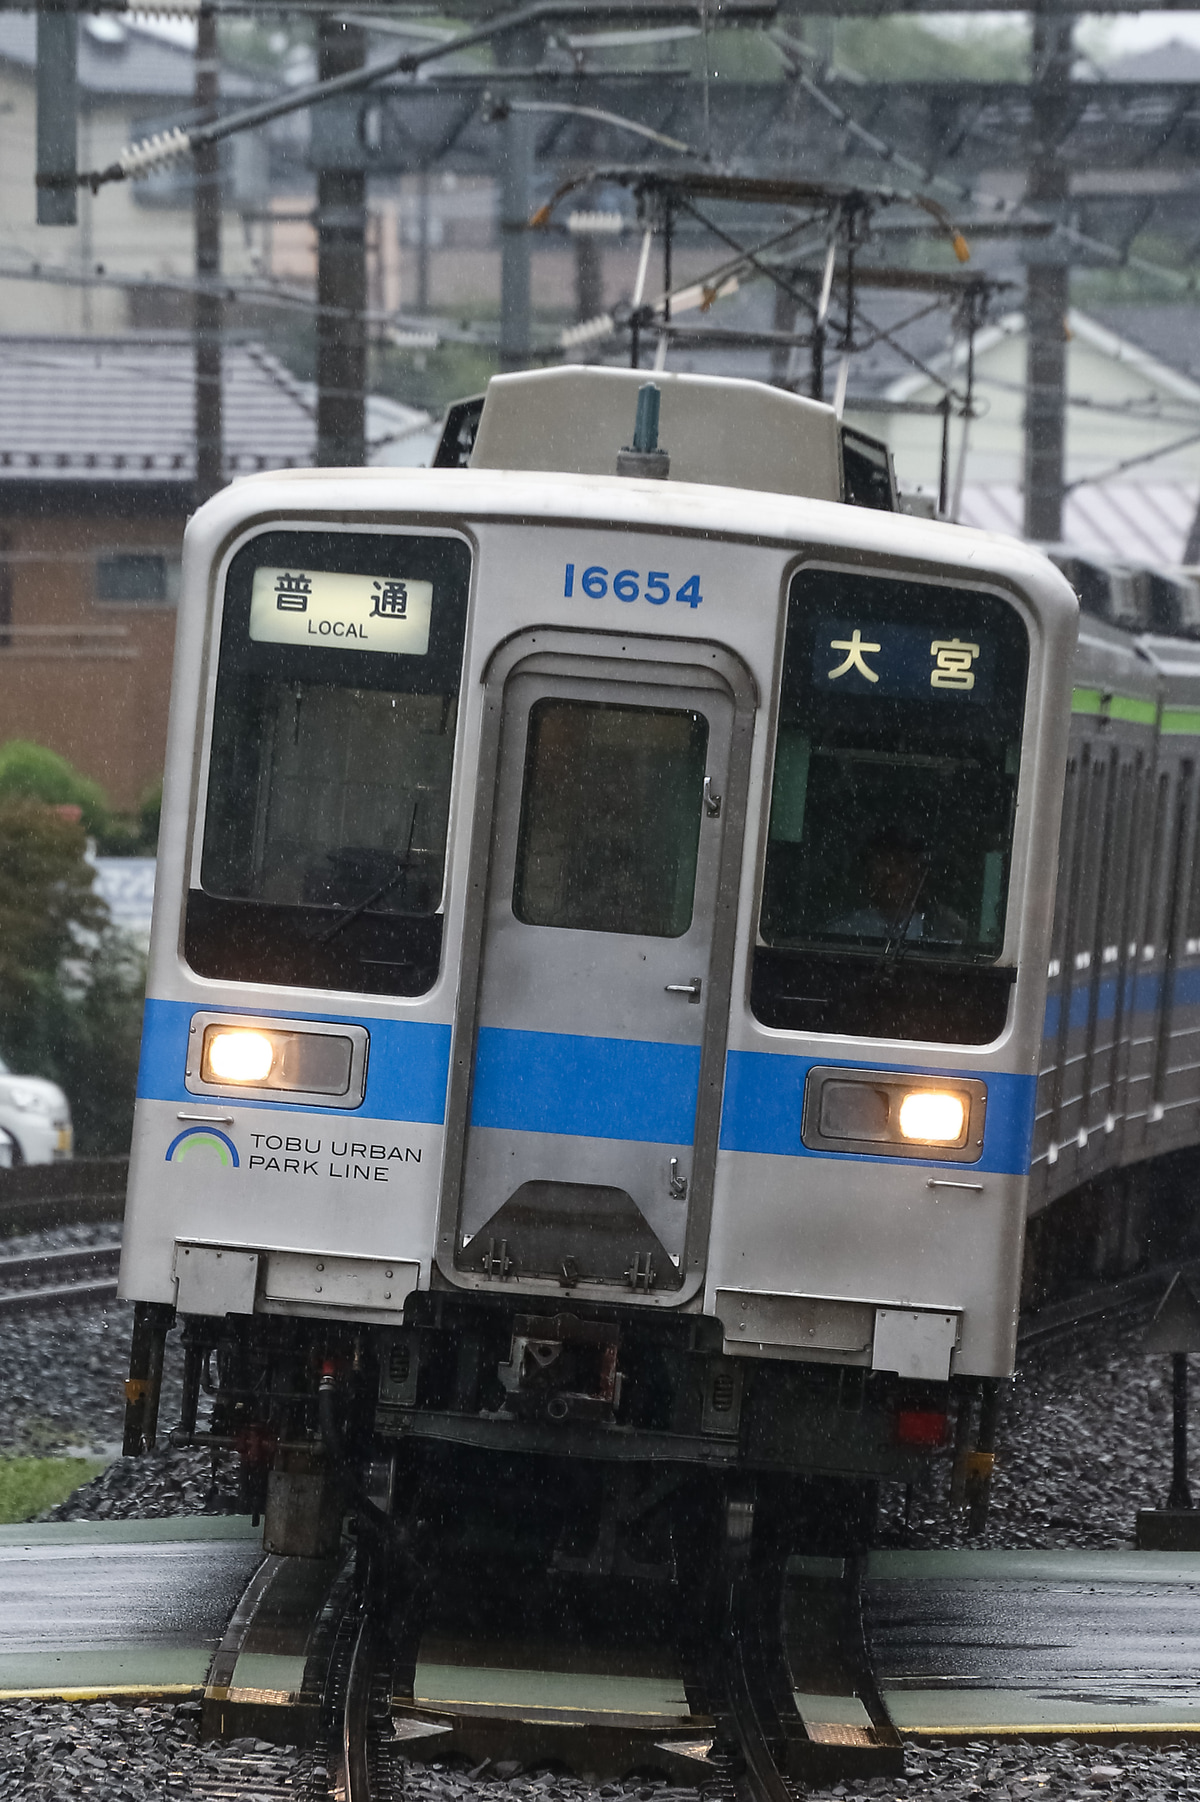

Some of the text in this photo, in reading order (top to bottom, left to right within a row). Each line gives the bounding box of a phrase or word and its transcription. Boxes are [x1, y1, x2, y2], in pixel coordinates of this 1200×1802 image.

[274, 572, 408, 620] 普通
[564, 563, 703, 609] 16654
[307, 619, 369, 639] LOCAL
[828, 629, 980, 690] 大宮
[250, 1133, 422, 1163] TOBU URBAN
[249, 1155, 389, 1182] PARK LINE
